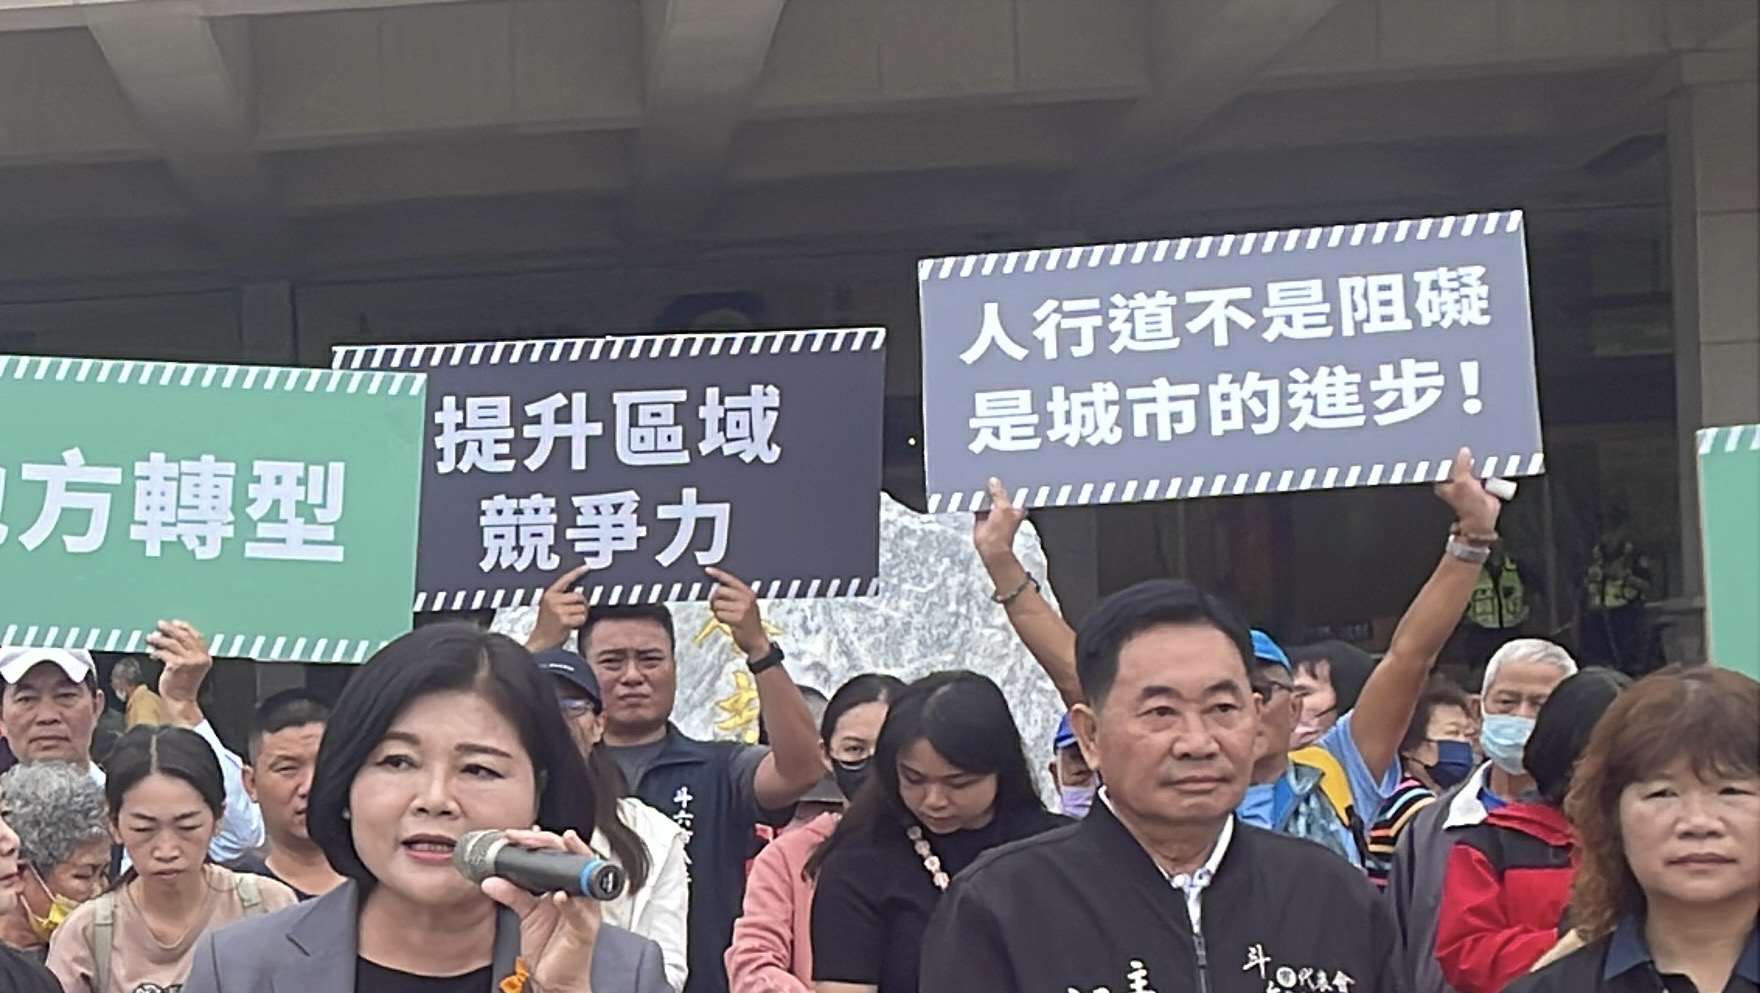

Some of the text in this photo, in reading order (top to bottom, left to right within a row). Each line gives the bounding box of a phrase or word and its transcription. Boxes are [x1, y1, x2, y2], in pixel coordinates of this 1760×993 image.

[959, 264, 1492, 366] 人行道不是阻礙
[434, 384, 782, 474] 提升區域
[967, 358, 1483, 456] 是城市的進步!
[478, 487, 732, 573] 競爭力
